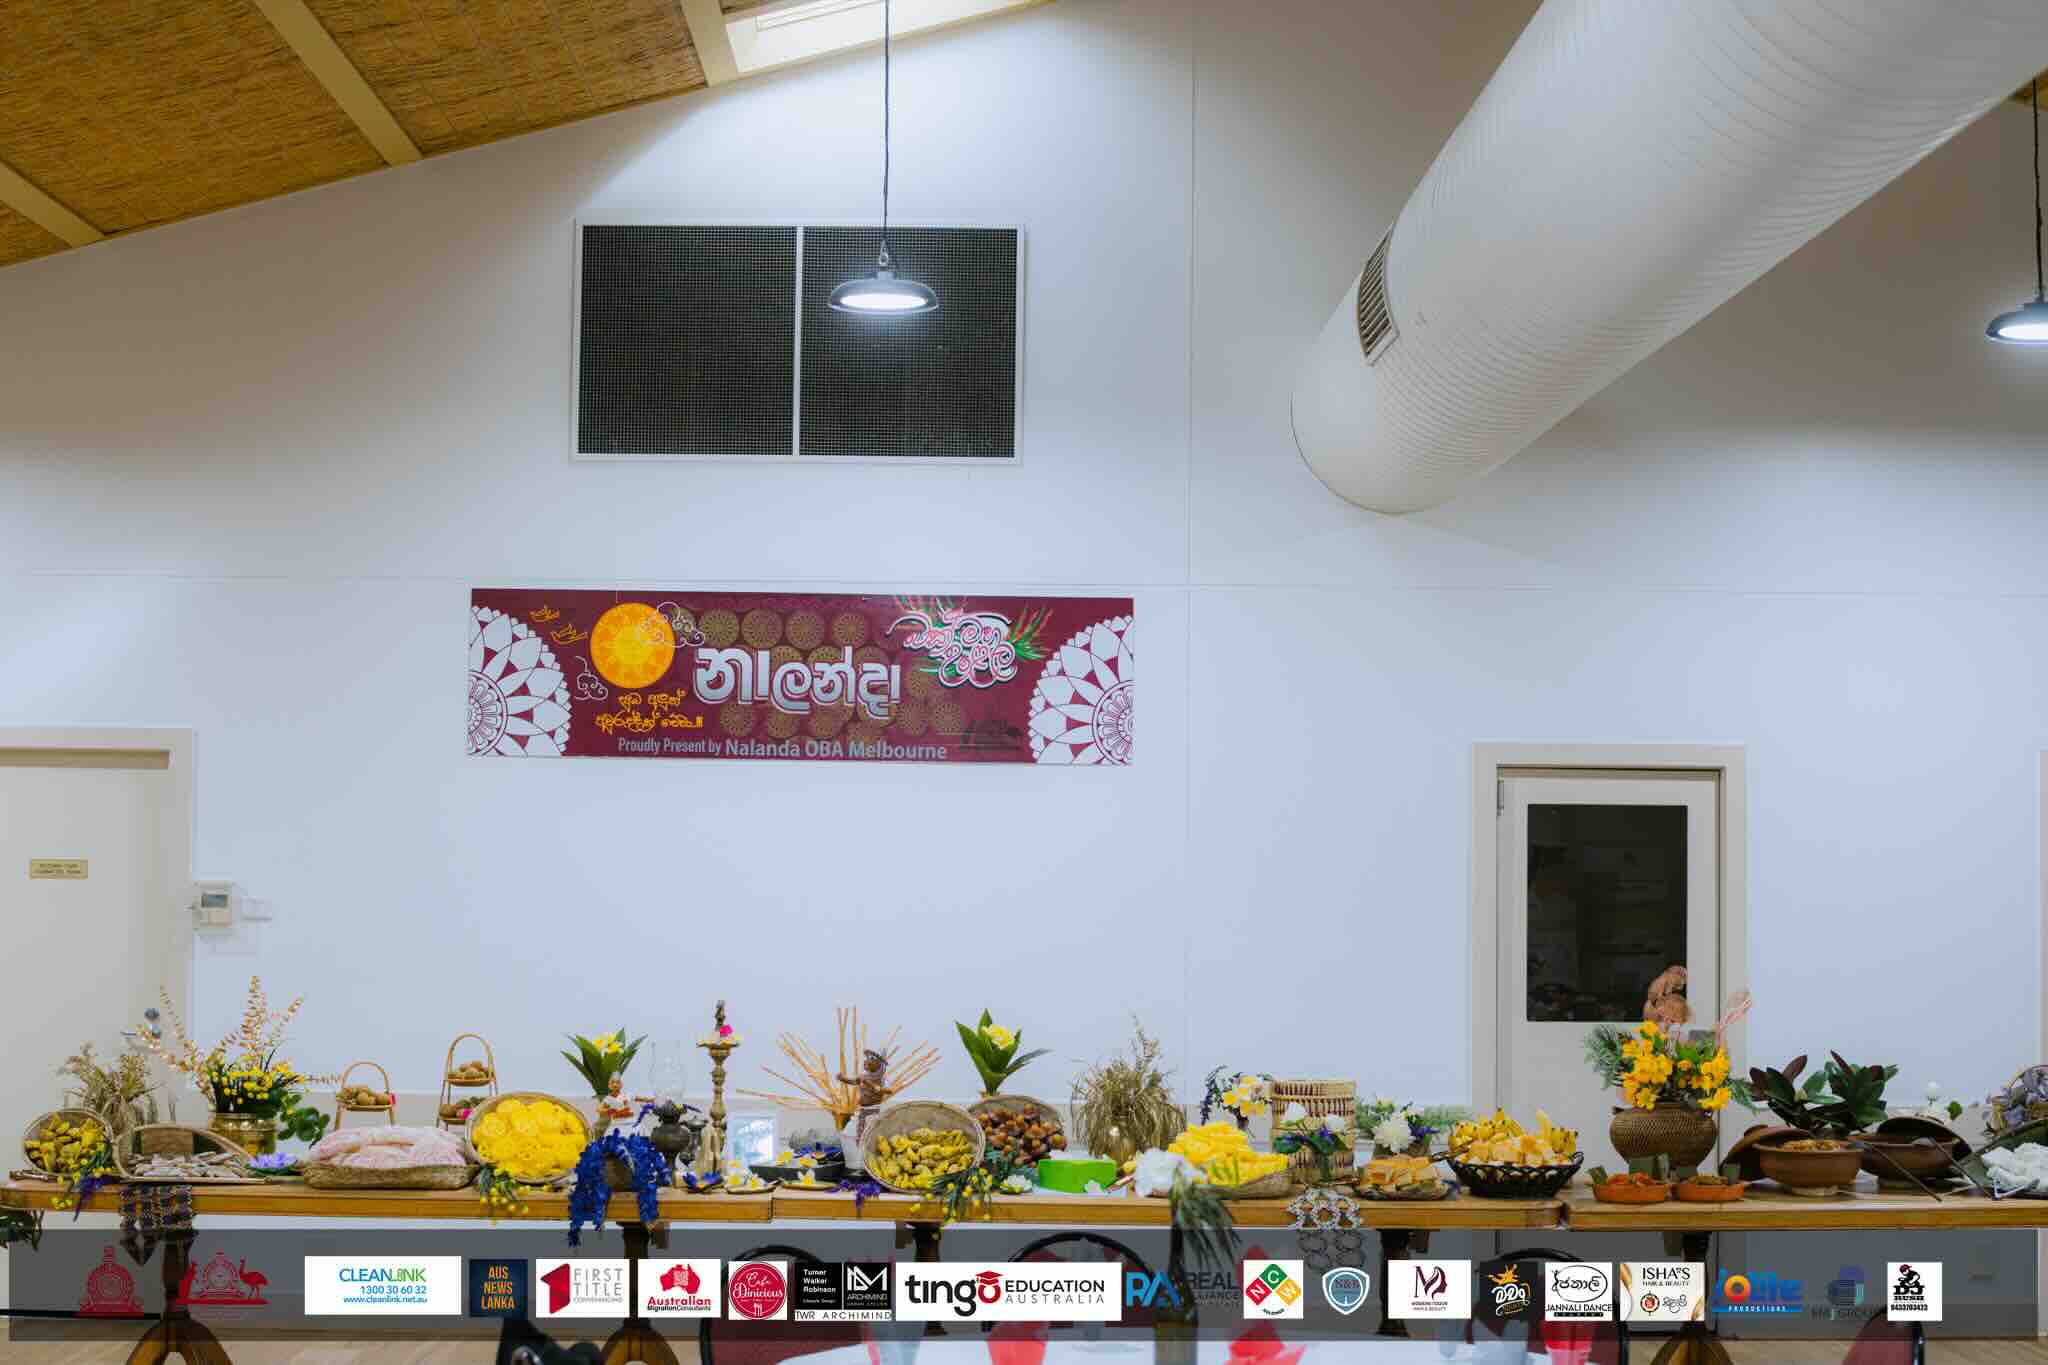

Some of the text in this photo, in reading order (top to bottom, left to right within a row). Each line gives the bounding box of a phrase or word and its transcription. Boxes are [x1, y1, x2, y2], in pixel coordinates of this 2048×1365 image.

[693, 645, 901, 719] නාලන්දා
[618, 738, 947, 760] Proudly Present by Nalanda OBA Melbourne
